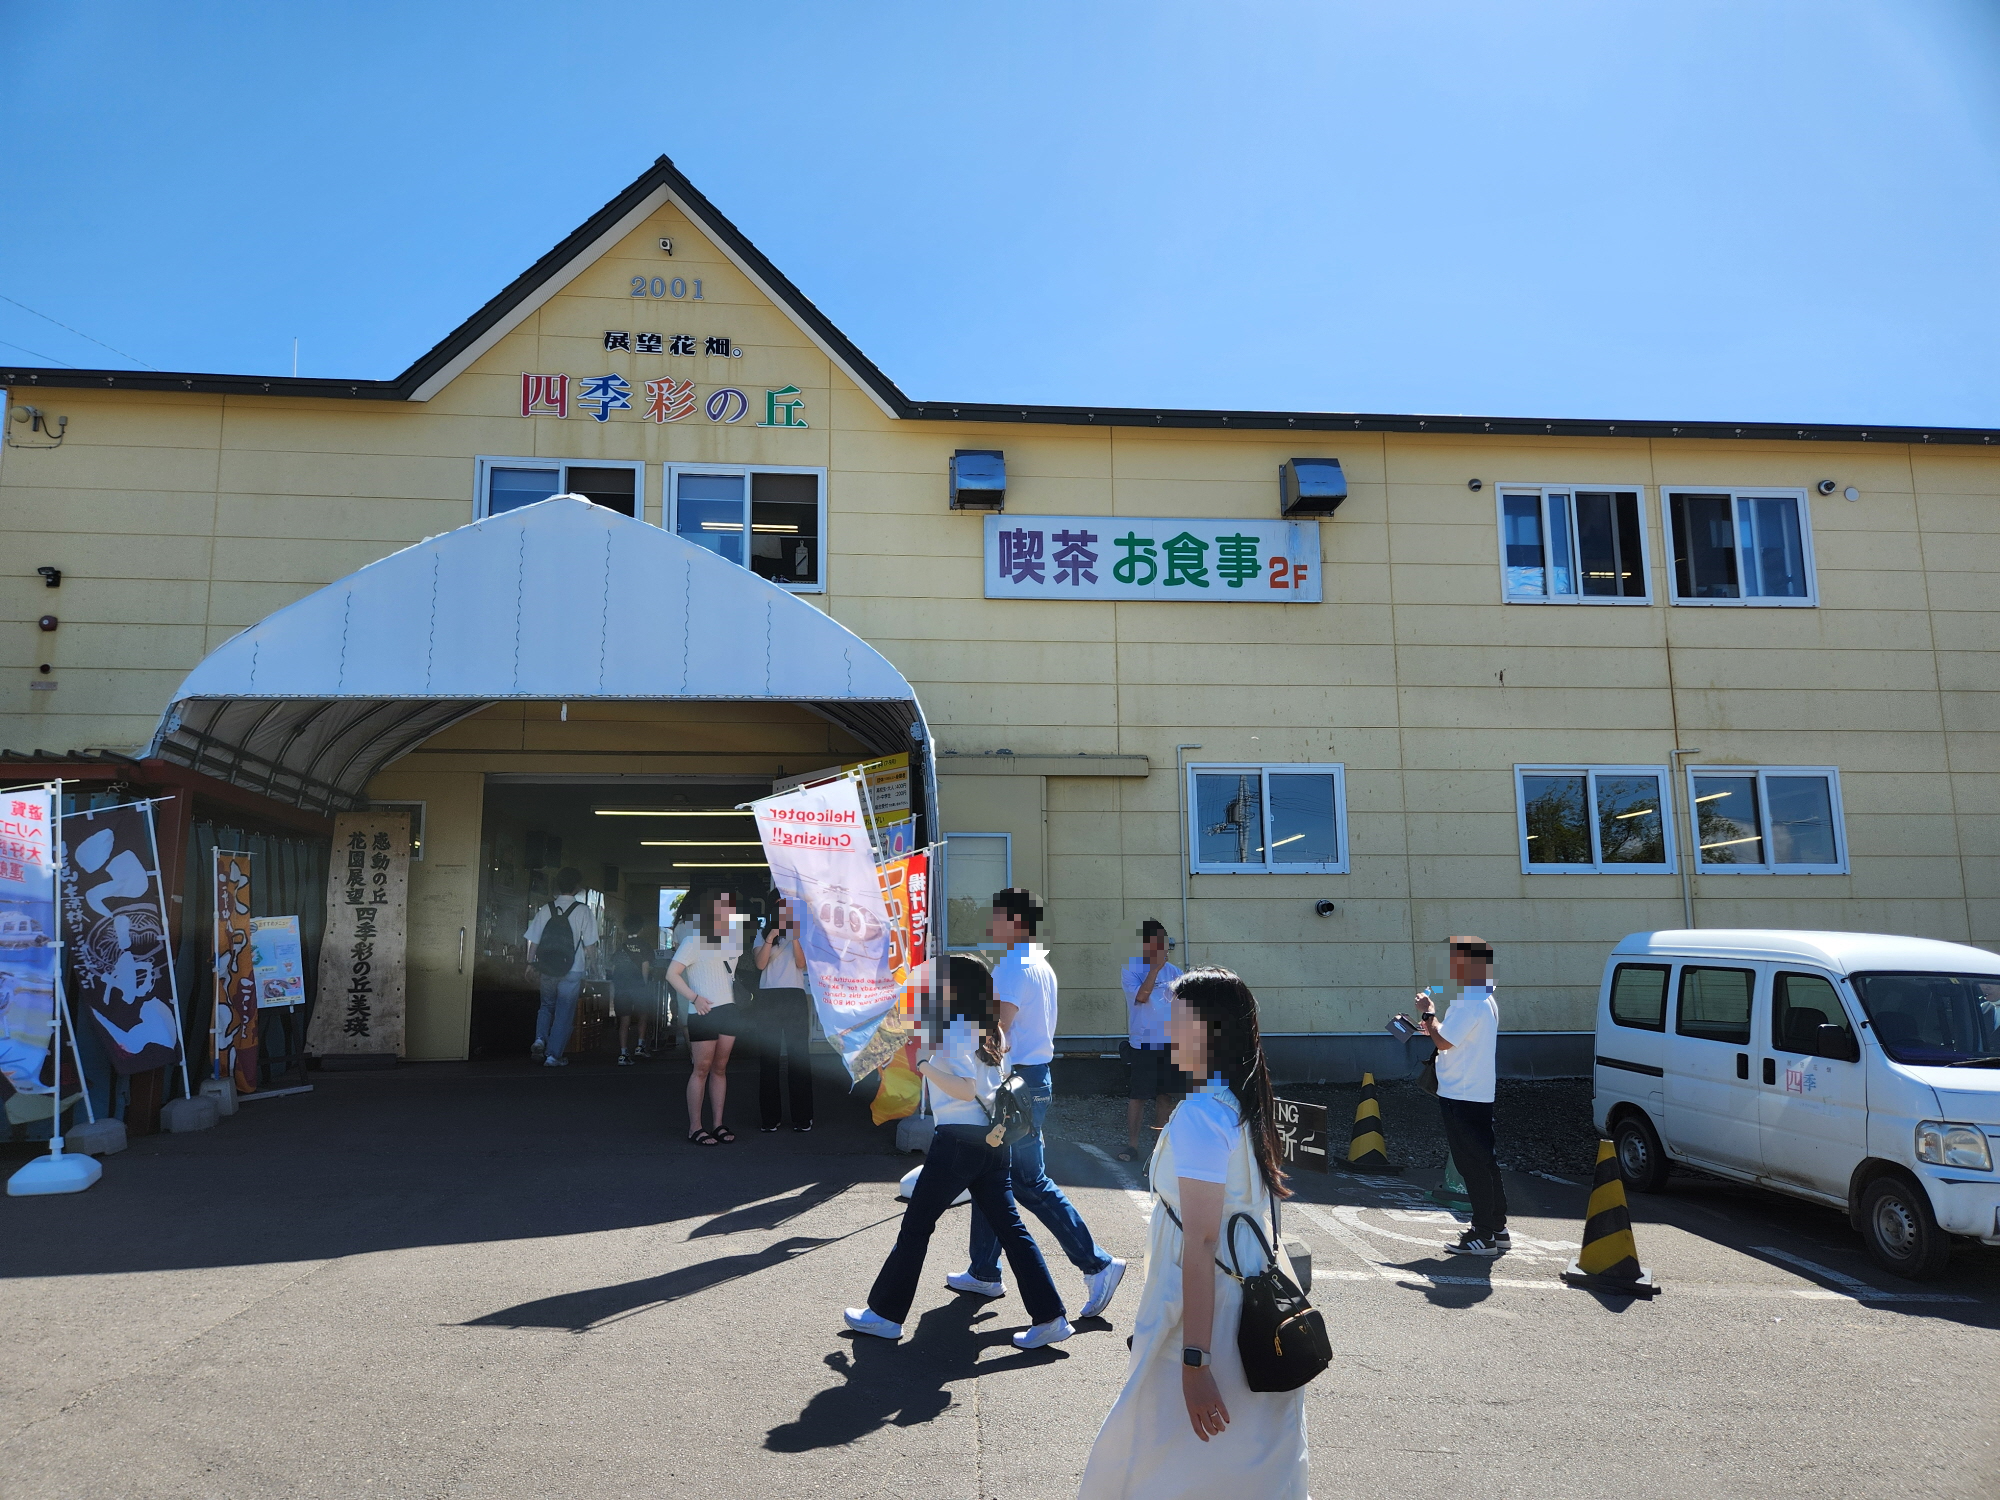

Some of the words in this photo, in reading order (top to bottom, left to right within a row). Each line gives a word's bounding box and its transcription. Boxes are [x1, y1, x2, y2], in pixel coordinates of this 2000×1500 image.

[630, 276, 704, 300] 2001
[603, 331, 743, 359] 展望花畑。
[520, 371, 809, 429] 四季彩の丘
[998, 527, 1099, 586] 喫茶
[1112, 531, 1262, 589] お食事
[1268, 556, 1308, 589] 2F
[345, 831, 367, 905] 花園展望
[368, 831, 391, 905] 感動の丘
[343, 907, 378, 1038] 四季彩の丘美瑛
[1786, 1068, 1817, 1094] 四季
[1272, 1101, 1300, 1123] ING
[1275, 1124, 1298, 1162] 所
